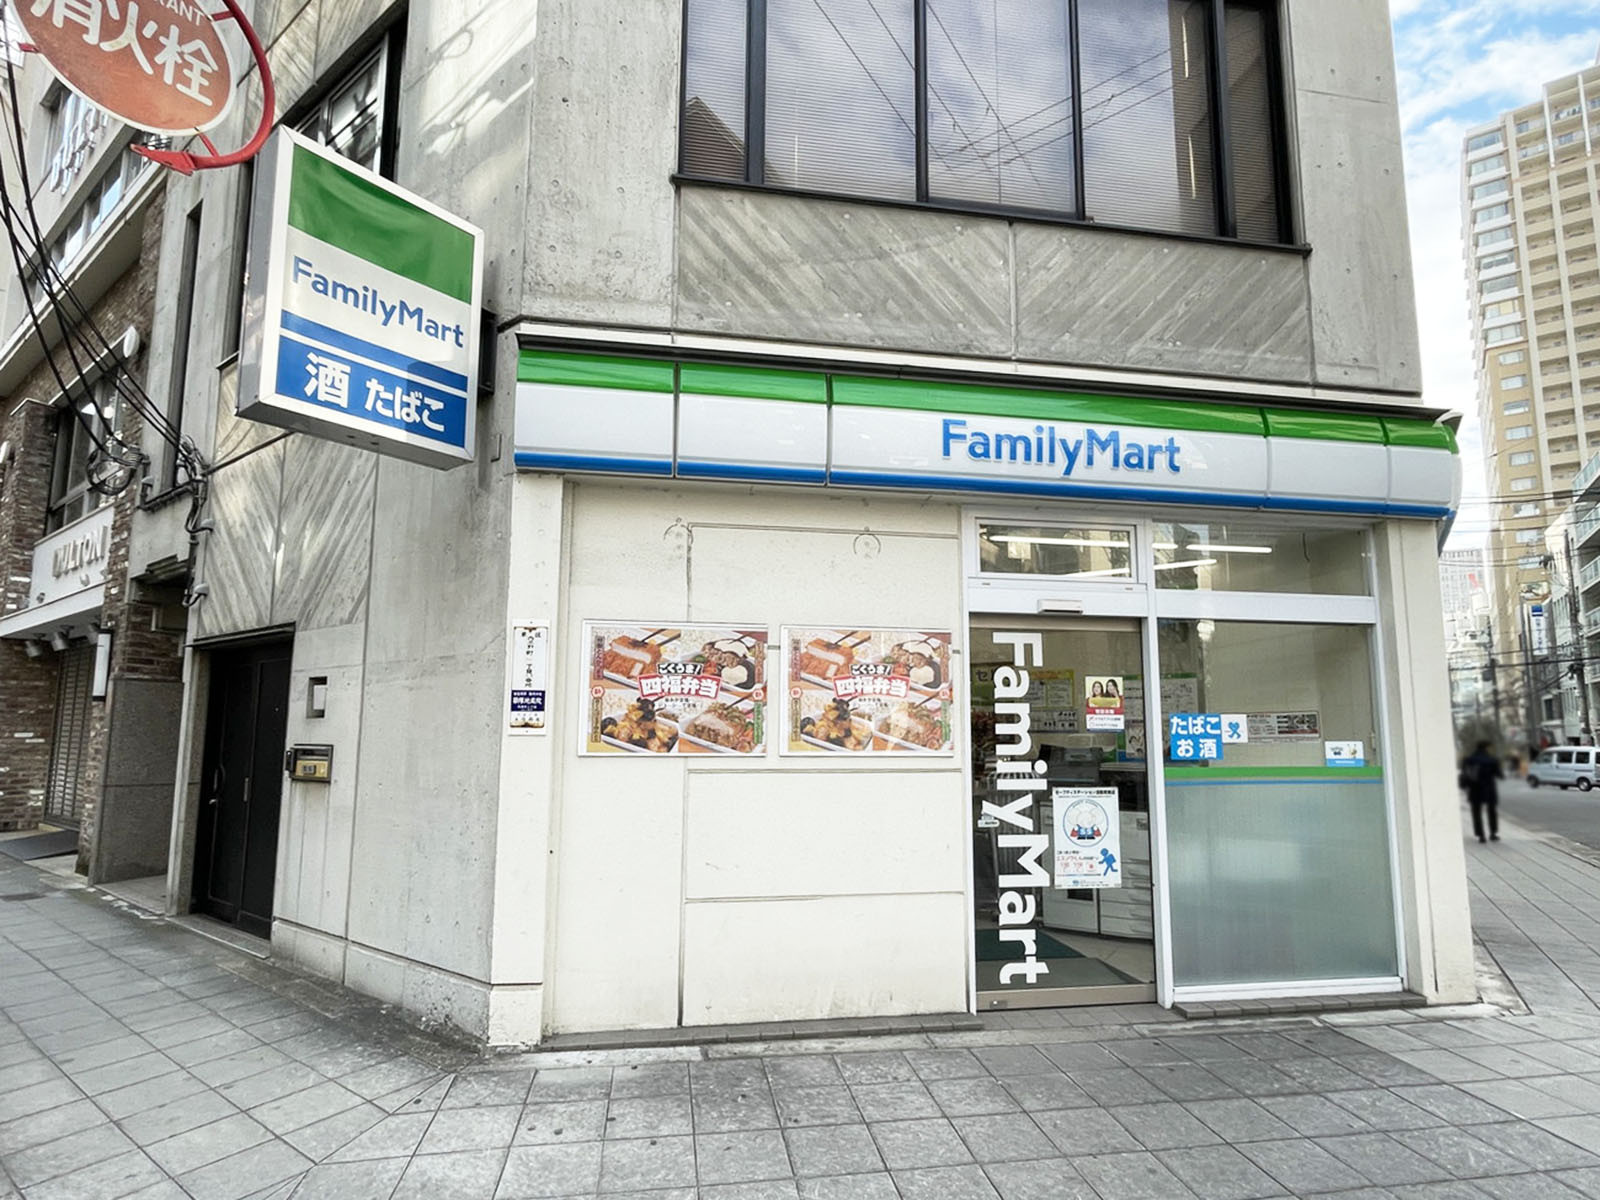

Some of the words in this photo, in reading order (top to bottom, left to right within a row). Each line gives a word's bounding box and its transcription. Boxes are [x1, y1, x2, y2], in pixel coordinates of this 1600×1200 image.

[292, 256, 465, 349] FamilyMart
[304, 351, 349, 410] 酒
[365, 379, 445, 432] たばこ
[942, 418, 1181, 476] FamilyMart
[1170, 715, 1221, 735] たばこ
[1177, 738, 1217, 759] お酒
[981, 632, 1051, 984] FamilyMart
